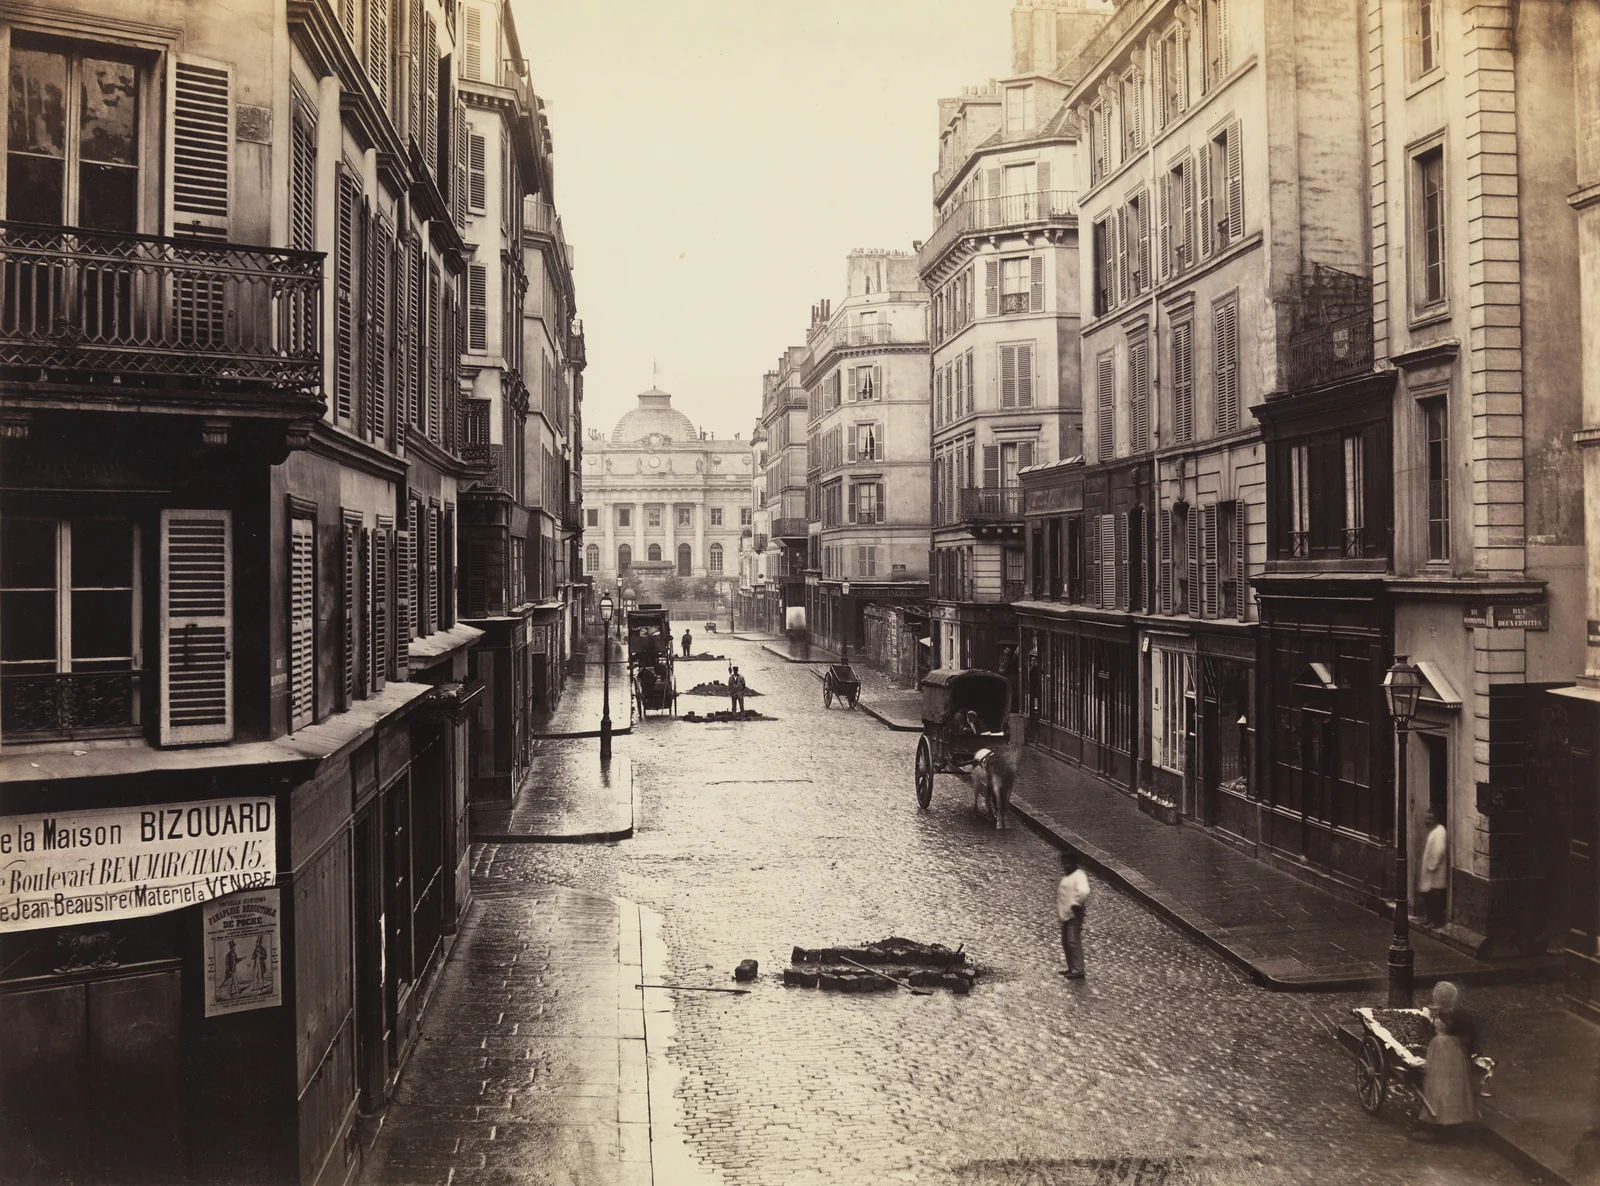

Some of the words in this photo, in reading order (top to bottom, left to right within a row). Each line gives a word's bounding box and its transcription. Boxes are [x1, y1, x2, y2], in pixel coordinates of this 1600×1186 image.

[18, 824, 35, 853] la
[43, 818, 122, 850] Maison
[140, 802, 271, 842] BIZOUARD
[11, 891, 128, 922] Jean-Beausire
[208, 905, 241, 926] PARAPLUIE
[236, 916, 263, 927] POCHE
